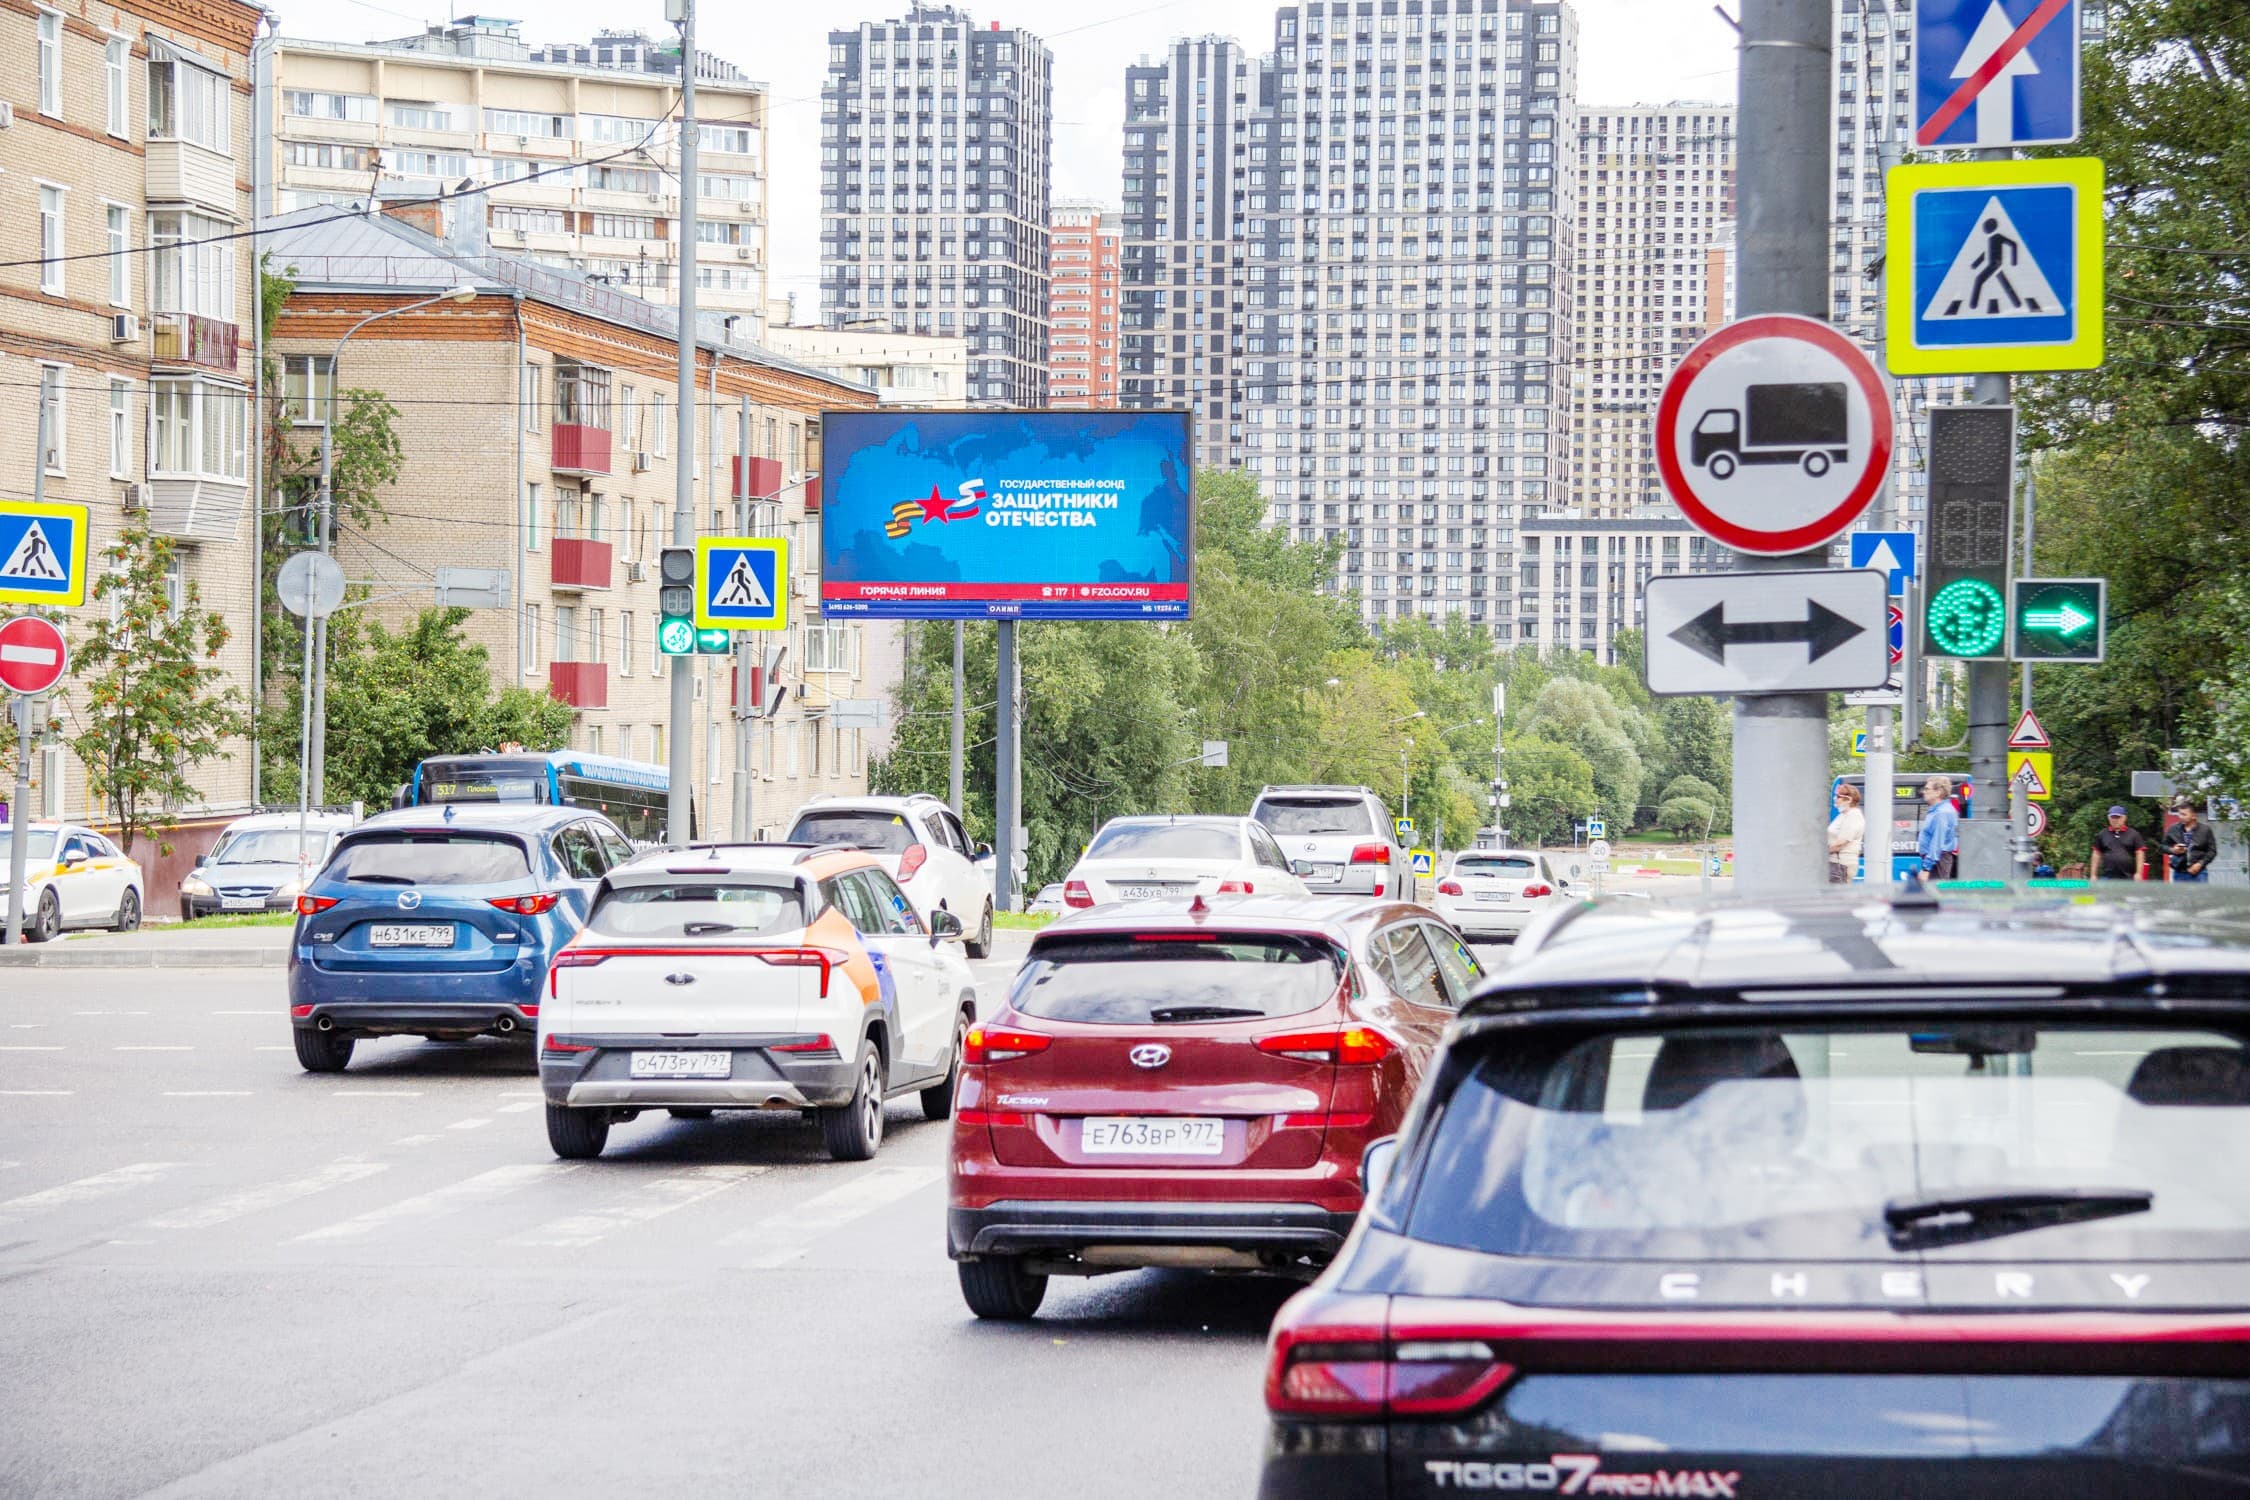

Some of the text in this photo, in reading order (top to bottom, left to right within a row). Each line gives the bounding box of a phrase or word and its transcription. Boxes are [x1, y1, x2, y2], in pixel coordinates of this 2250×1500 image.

[1000, 479, 1125, 490] ГОСУДАРСТВЕННЫЙ ФОНД
[992, 493, 1118, 510] ЗАЩИТНИКИ
[985, 511, 1096, 526] ОТЕЧЕСТВА
[860, 586, 946, 596] ГОРЯЧАЯ ЛИНИЯ
[1055, 587, 1150, 597] 117 FZO.GOV.RU
[437, 784, 457, 796] 317
[375, 927, 450, 942] Н631КЕ 799
[703, 1054, 726, 1067] 797
[996, 1095, 1049, 1106] TUCSON
[1182, 1122, 1214, 1139] 977
[1659, 1272, 2150, 1298] CHERY
